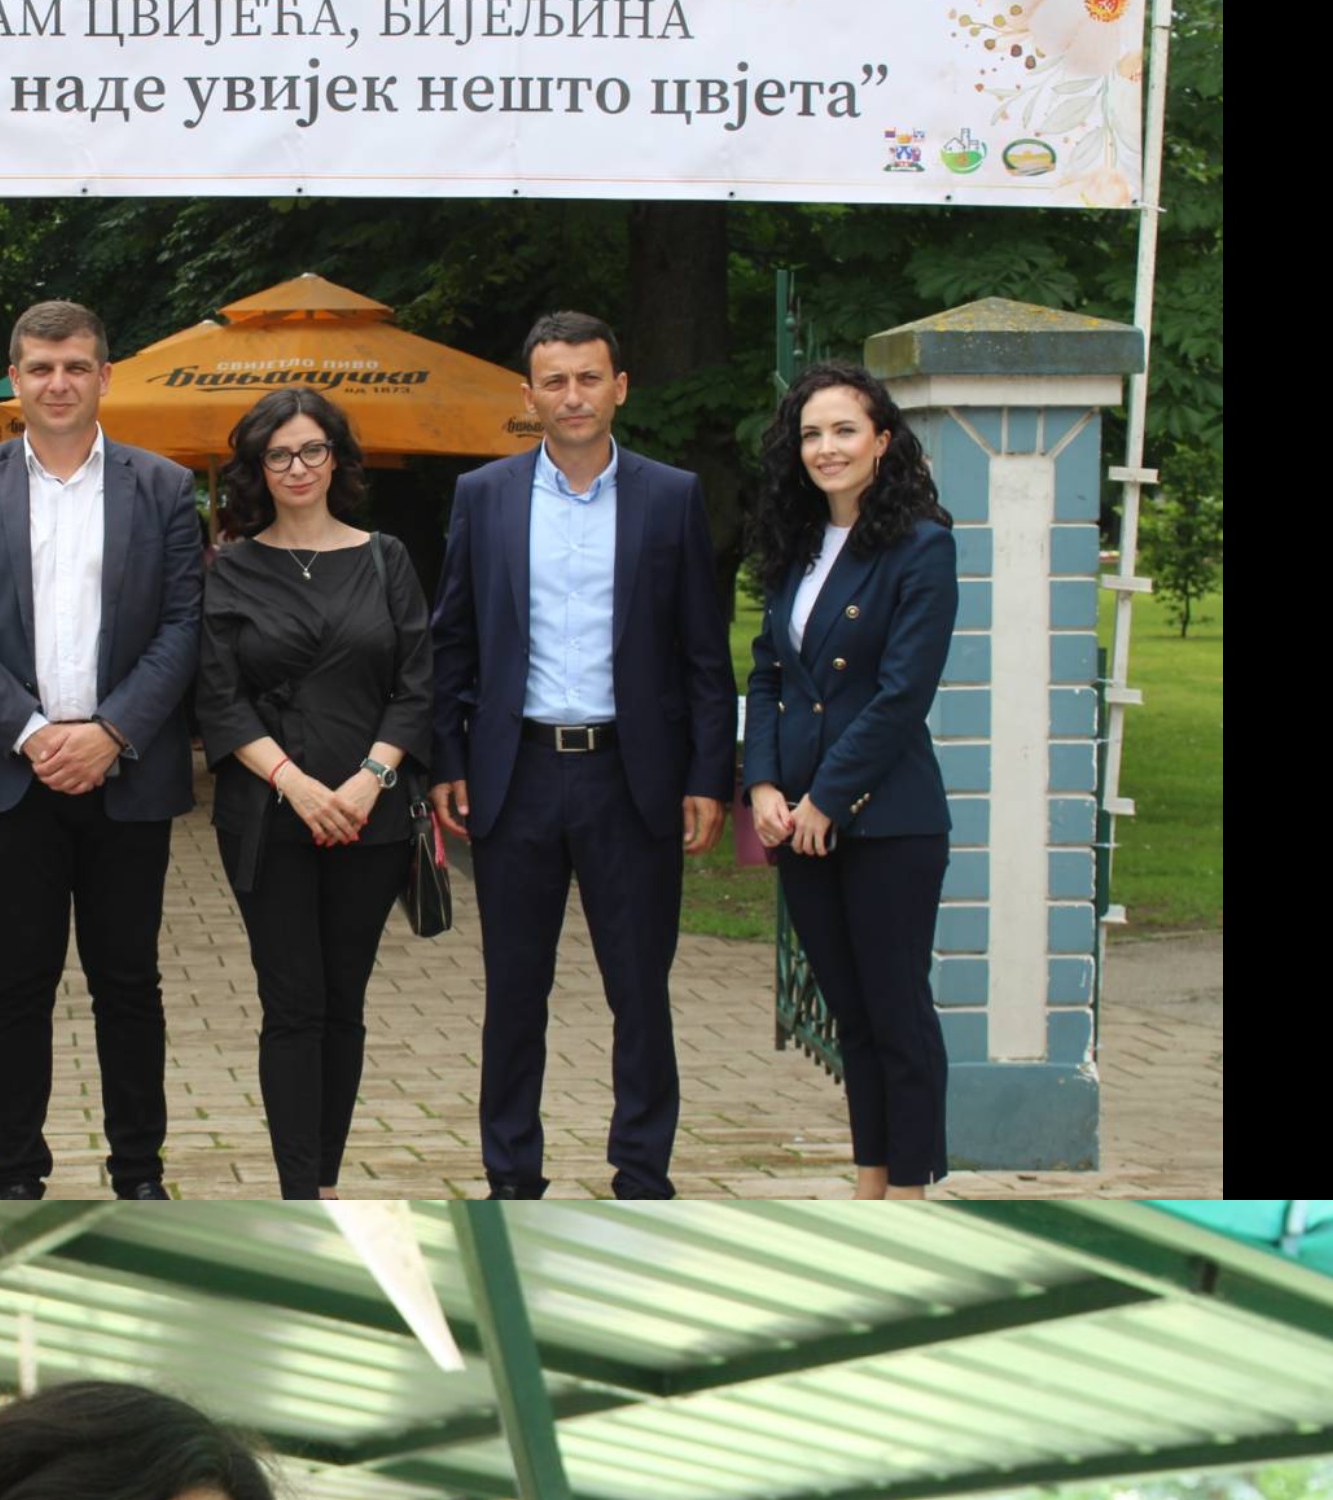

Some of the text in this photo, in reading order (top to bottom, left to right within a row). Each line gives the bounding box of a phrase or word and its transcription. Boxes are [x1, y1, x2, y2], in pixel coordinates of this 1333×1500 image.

[84, 0, 360, 49] ЦВИЈЕЋА,
[379, 0, 695, 46] БИЈЕЉИНА
[10, 75, 166, 122] наде
[183, 57, 399, 129] увијек
[417, 73, 631, 115] нешто
